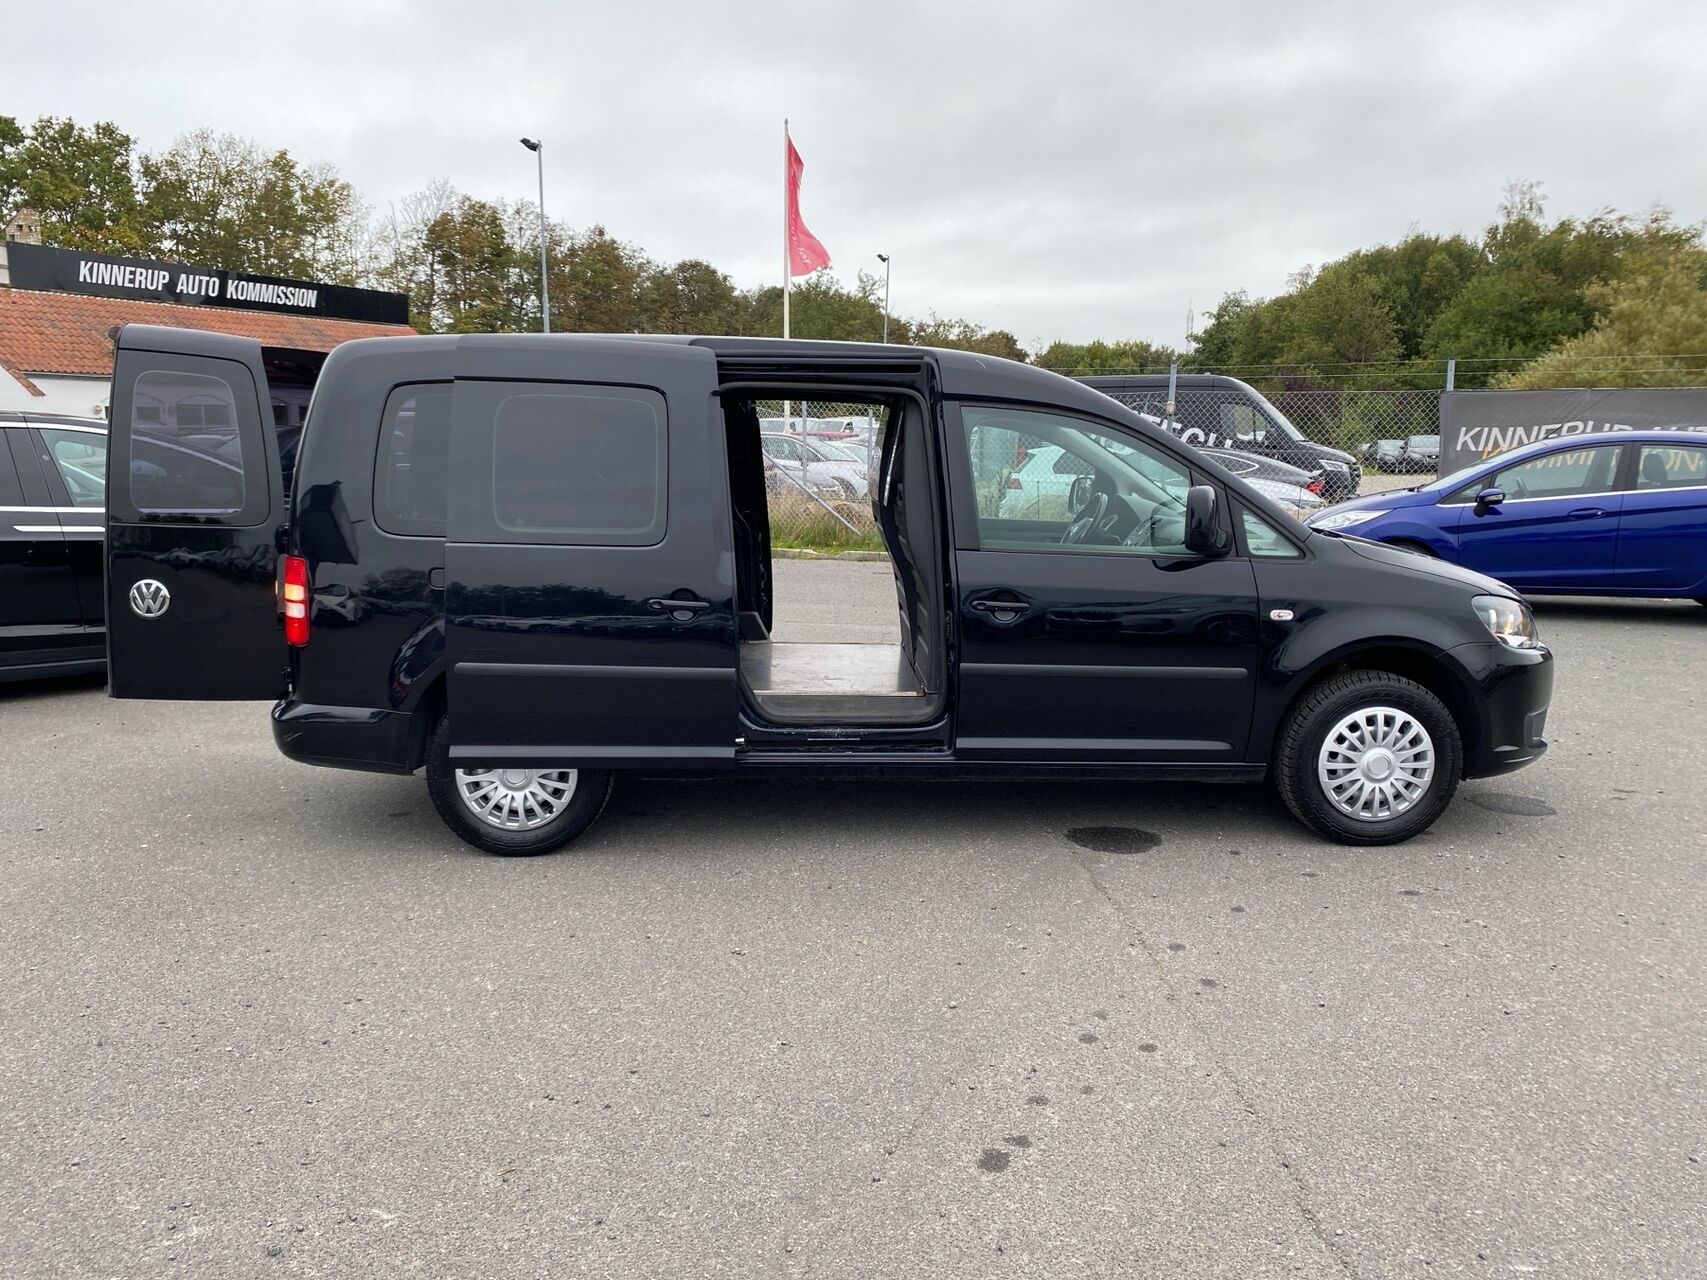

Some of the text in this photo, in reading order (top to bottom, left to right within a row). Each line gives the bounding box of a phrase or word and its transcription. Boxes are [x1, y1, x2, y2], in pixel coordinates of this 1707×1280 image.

[79, 260, 317, 308] KINNERUP AUTO KOMMISSION
